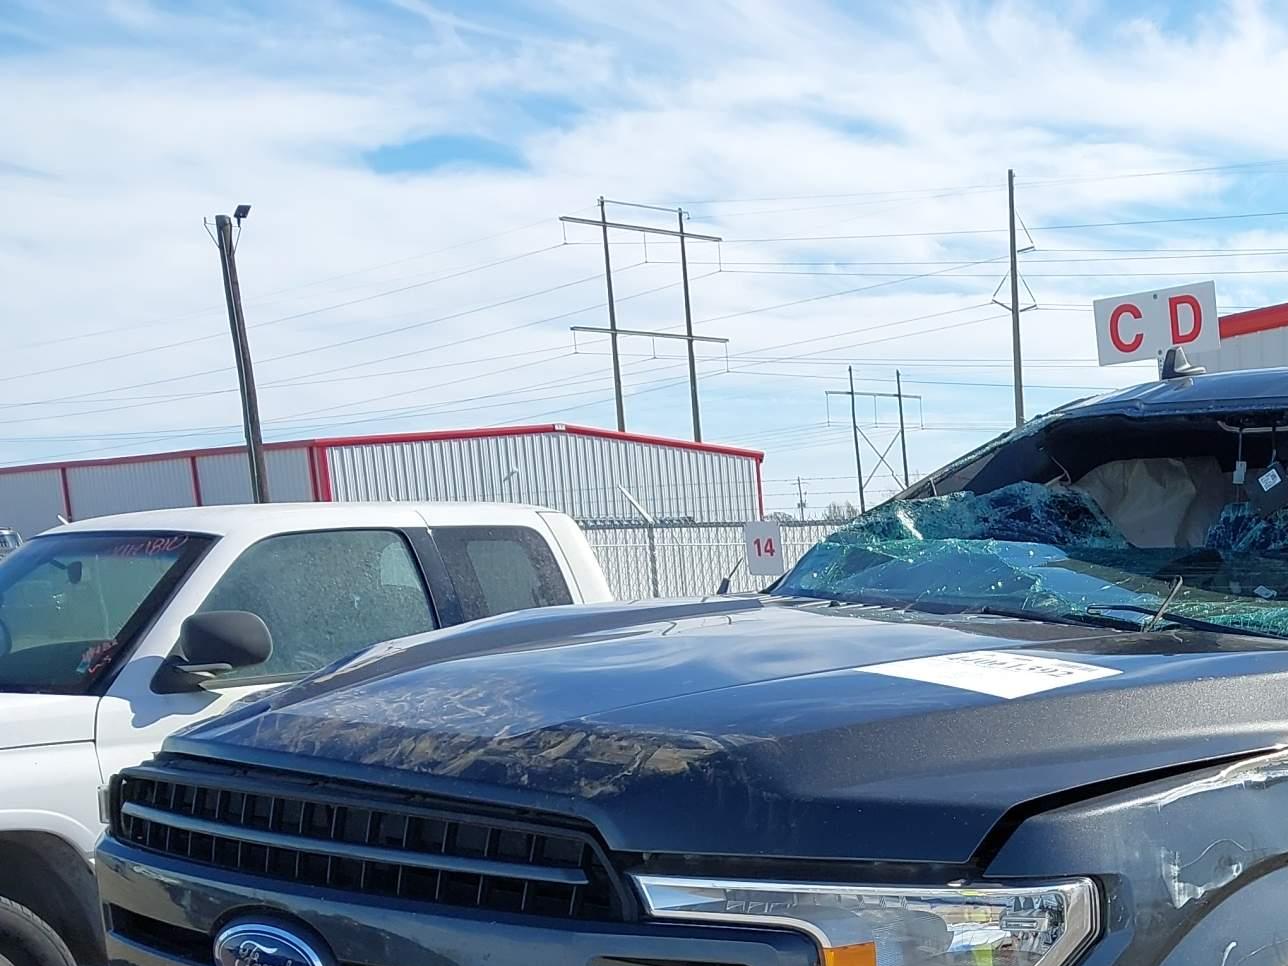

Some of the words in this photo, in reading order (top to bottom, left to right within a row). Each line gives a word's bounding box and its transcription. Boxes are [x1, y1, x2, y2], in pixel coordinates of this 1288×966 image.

[1109, 303, 1144, 354] C
[1168, 294, 1202, 345] D
[753, 537, 776, 557] 14
